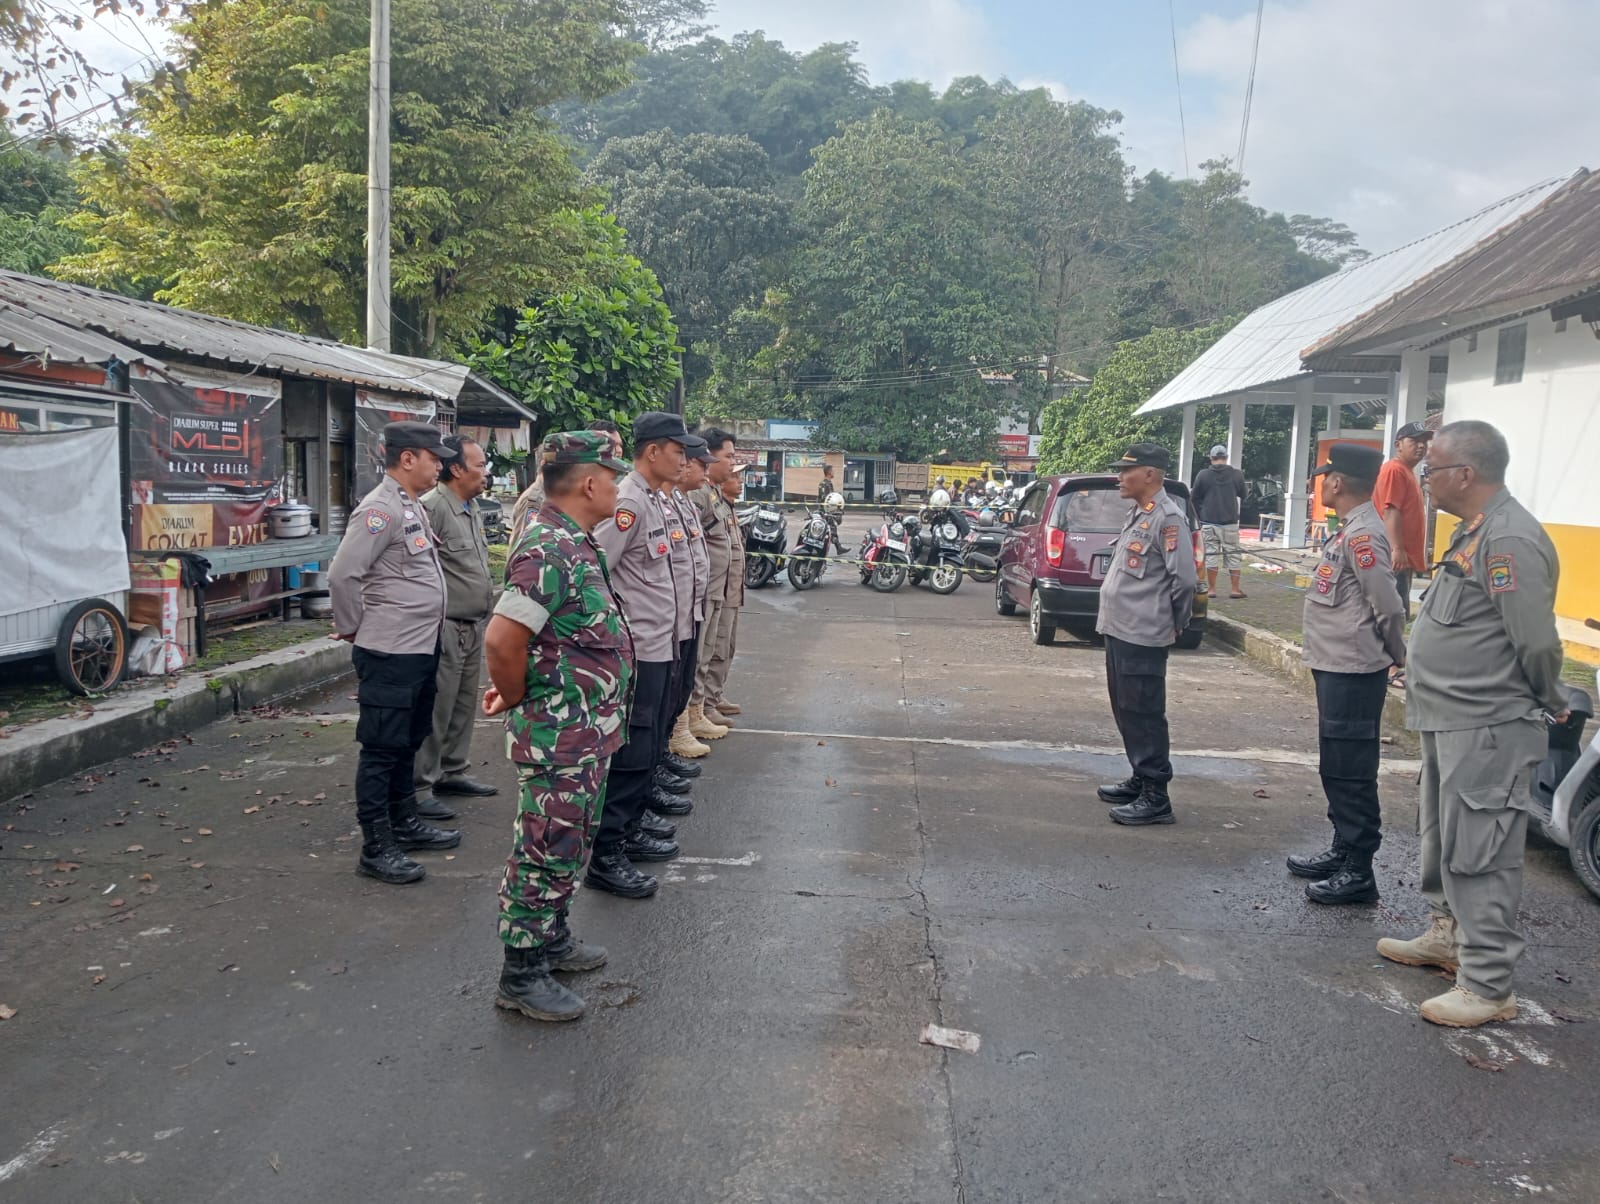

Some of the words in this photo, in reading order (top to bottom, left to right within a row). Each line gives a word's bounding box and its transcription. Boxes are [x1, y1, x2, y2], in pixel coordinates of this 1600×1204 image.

[173, 416, 200, 429] DJARUM
[200, 419, 220, 431] SUPER
[173, 430, 242, 451] MLD
[168, 461, 206, 473] BLACK
[213, 463, 249, 474] SERIES
[161, 517, 194, 530] DJARUM
